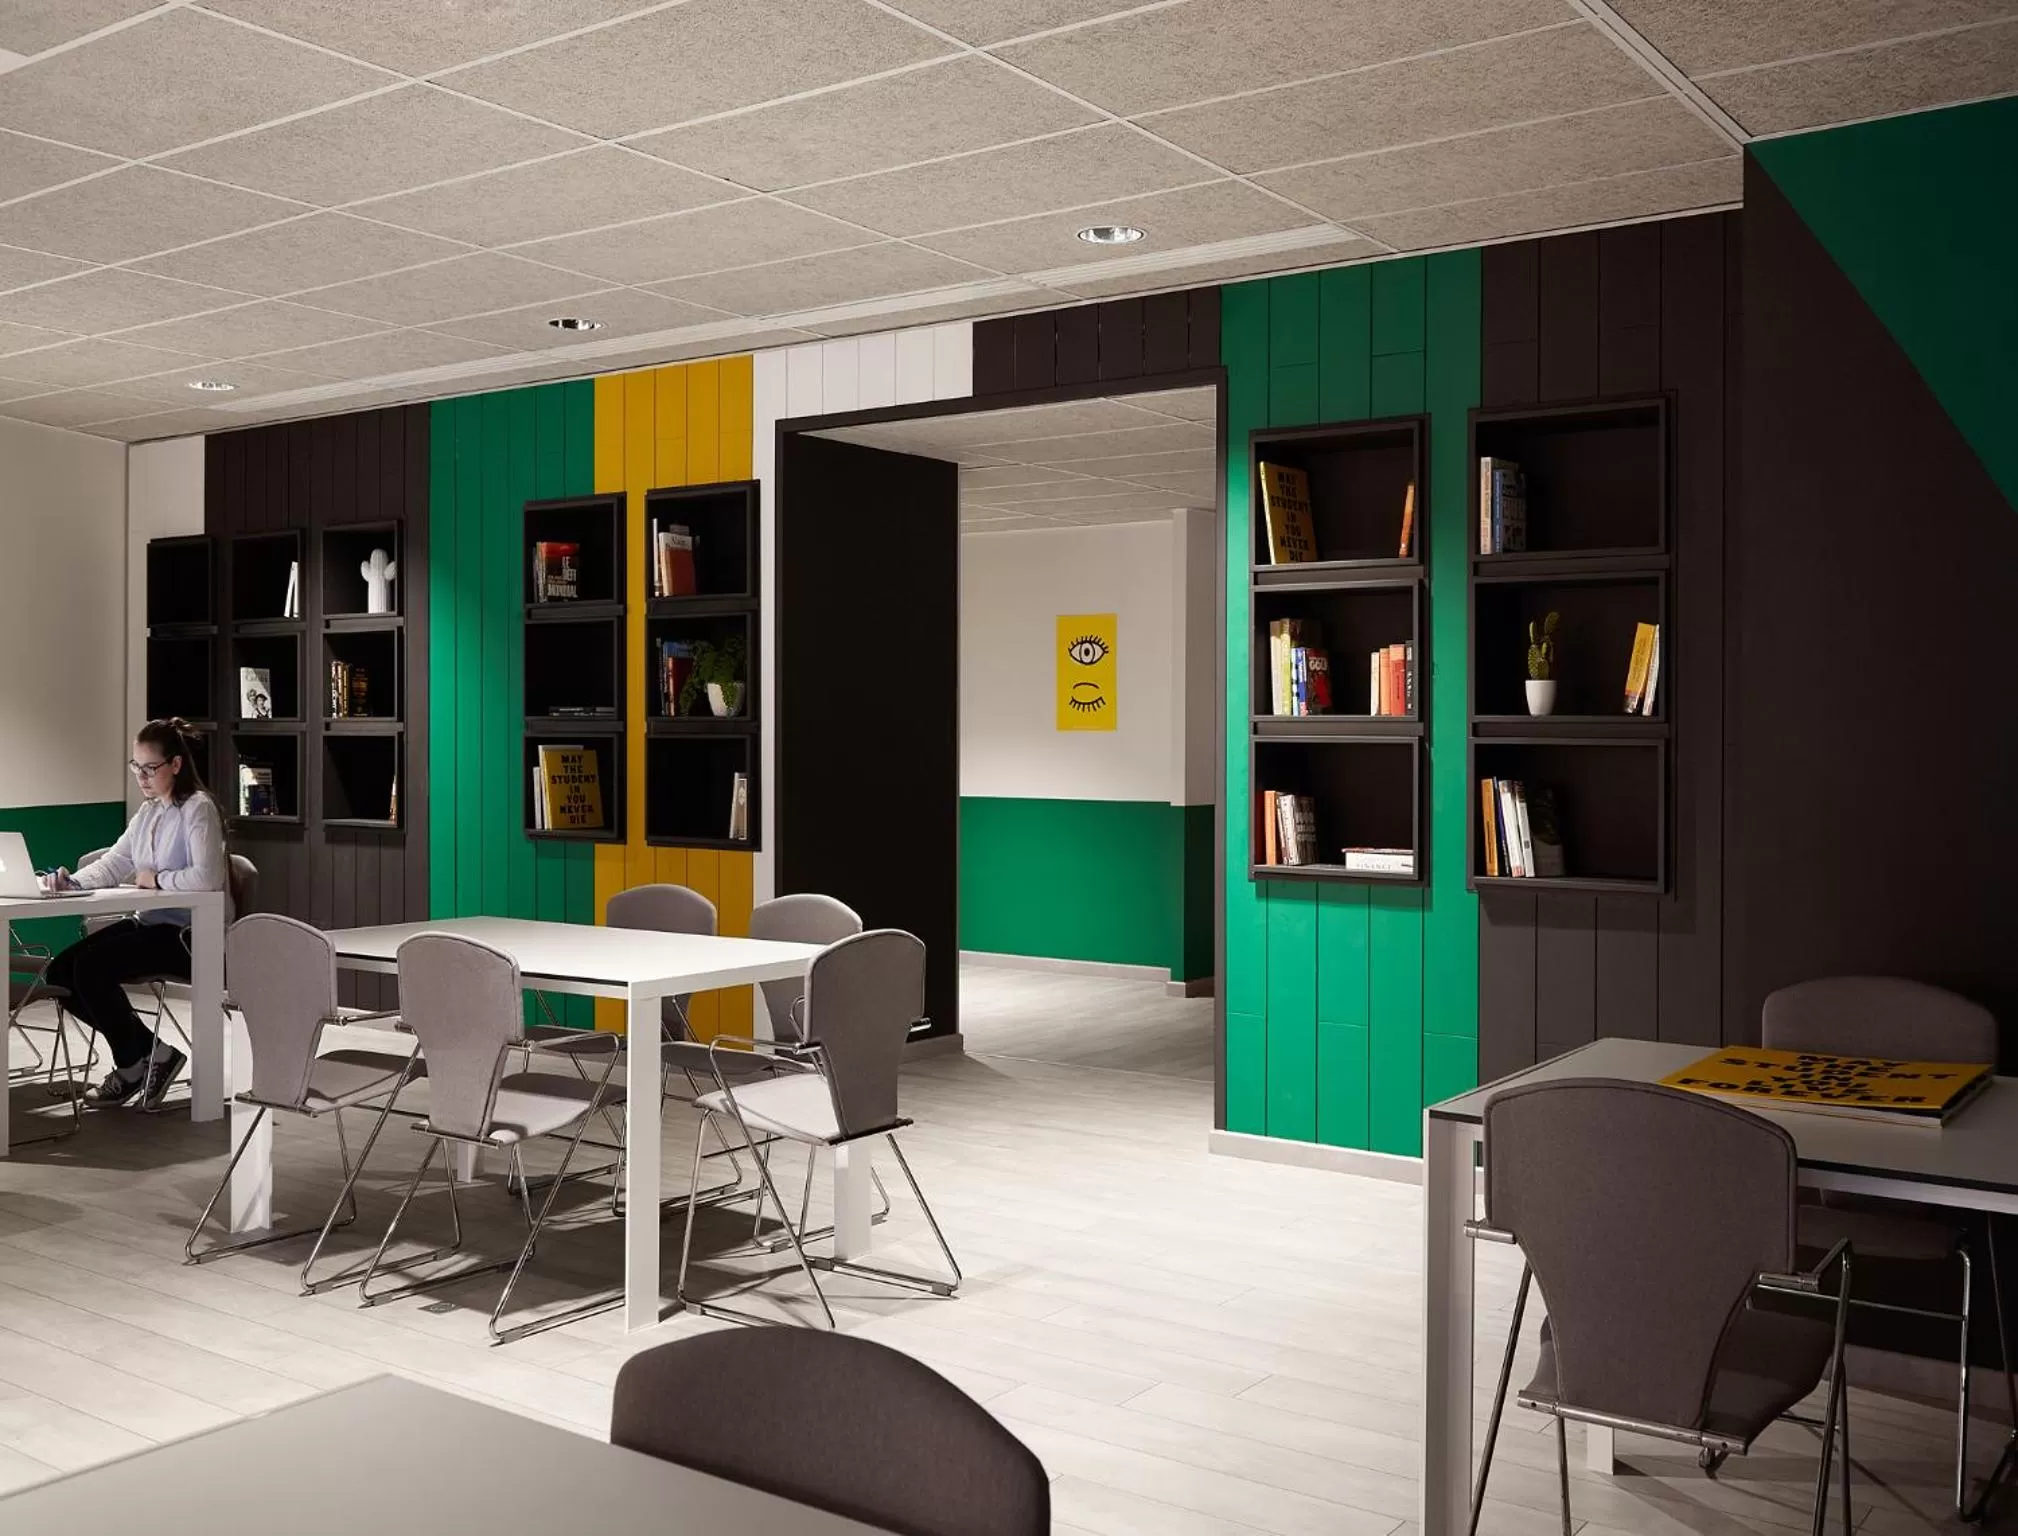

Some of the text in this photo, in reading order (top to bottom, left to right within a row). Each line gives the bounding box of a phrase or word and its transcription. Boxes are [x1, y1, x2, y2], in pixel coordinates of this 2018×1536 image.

[561, 754, 583, 764] MAY
[563, 764, 583, 774] THE
[551, 774, 597, 785] STUDENT
[569, 785, 581, 795] IN
[566, 794, 586, 804] YOU
[560, 804, 594, 814] NEVER
[569, 815, 587, 825] DIE
[1796, 1055, 1909, 1067] MAY
[1720, 1058, 1959, 1080] STUDENT
[1798, 1061, 1896, 1074] THE
[1770, 1075, 1870, 1089] YOU
[1677, 1078, 1928, 1103] FOREVER
